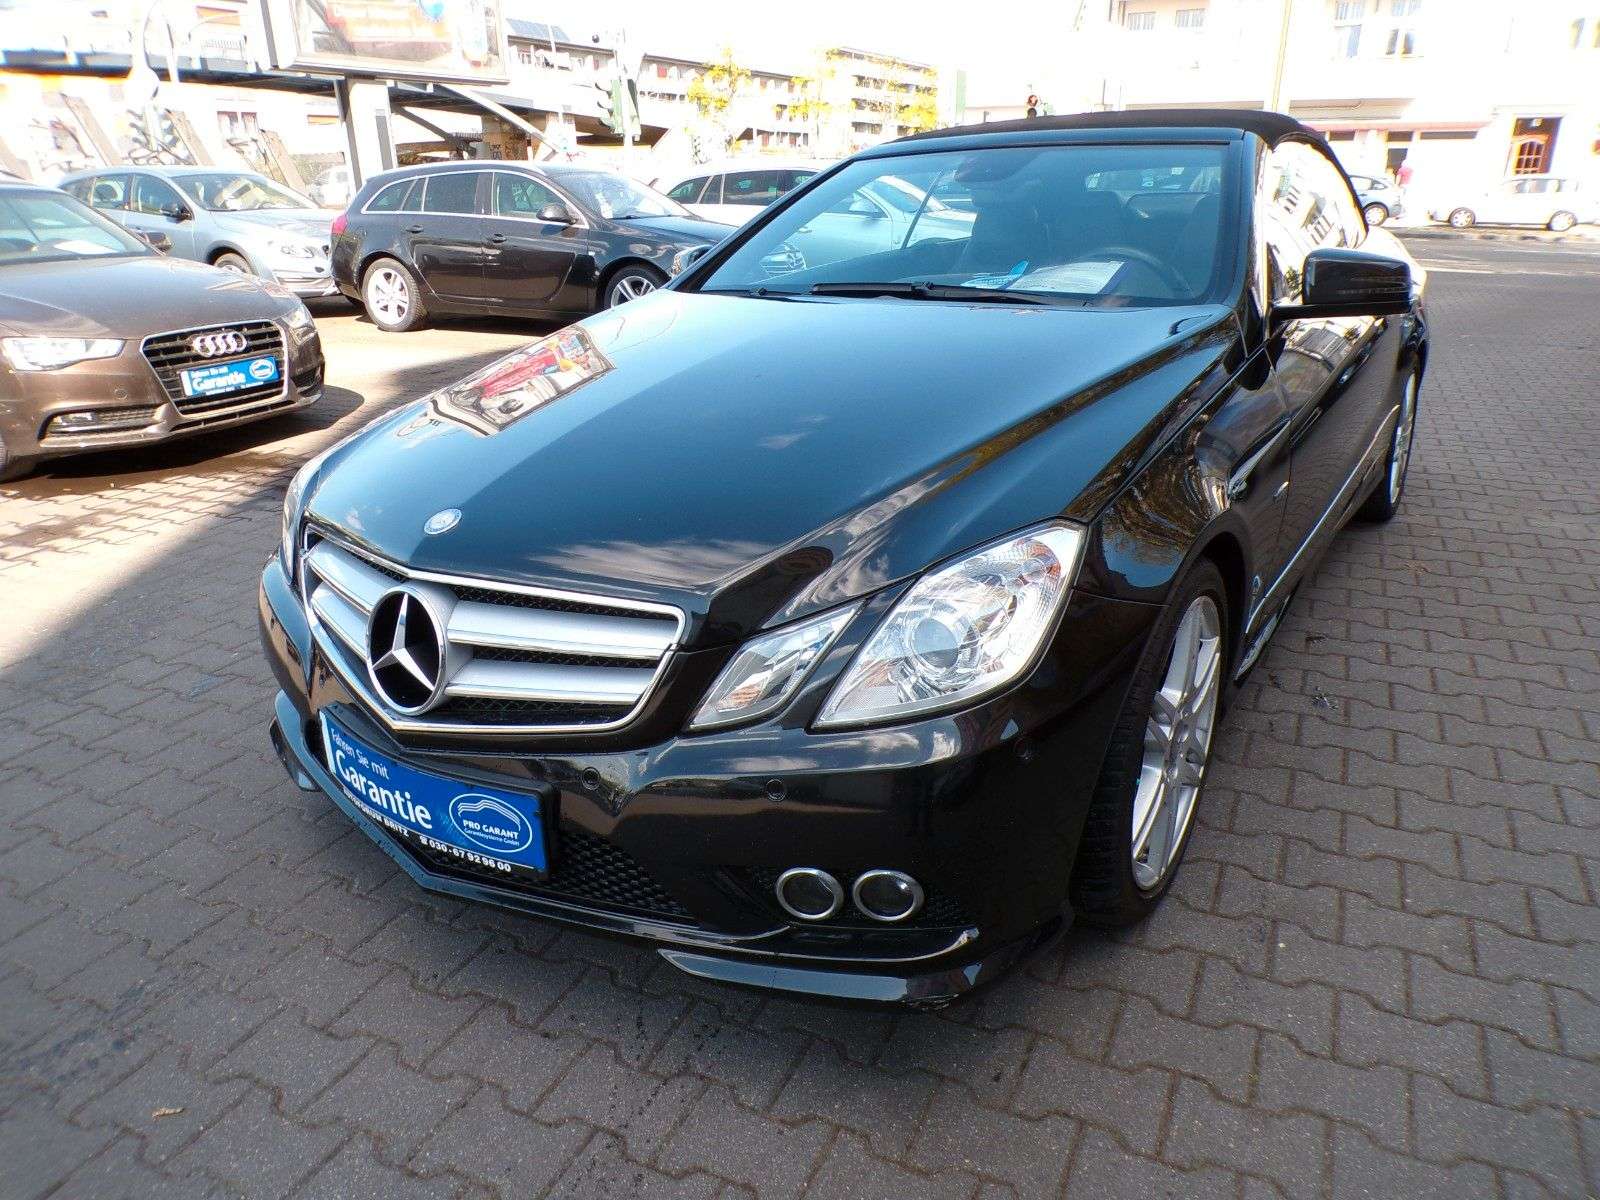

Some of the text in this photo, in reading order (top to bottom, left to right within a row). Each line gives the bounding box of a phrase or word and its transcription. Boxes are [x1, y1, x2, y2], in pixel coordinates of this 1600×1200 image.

[356, 749, 370, 768] Sie
[371, 762, 389, 780] mit
[335, 750, 432, 829] Garantie
[463, 820, 519, 840] PRO GARANT
